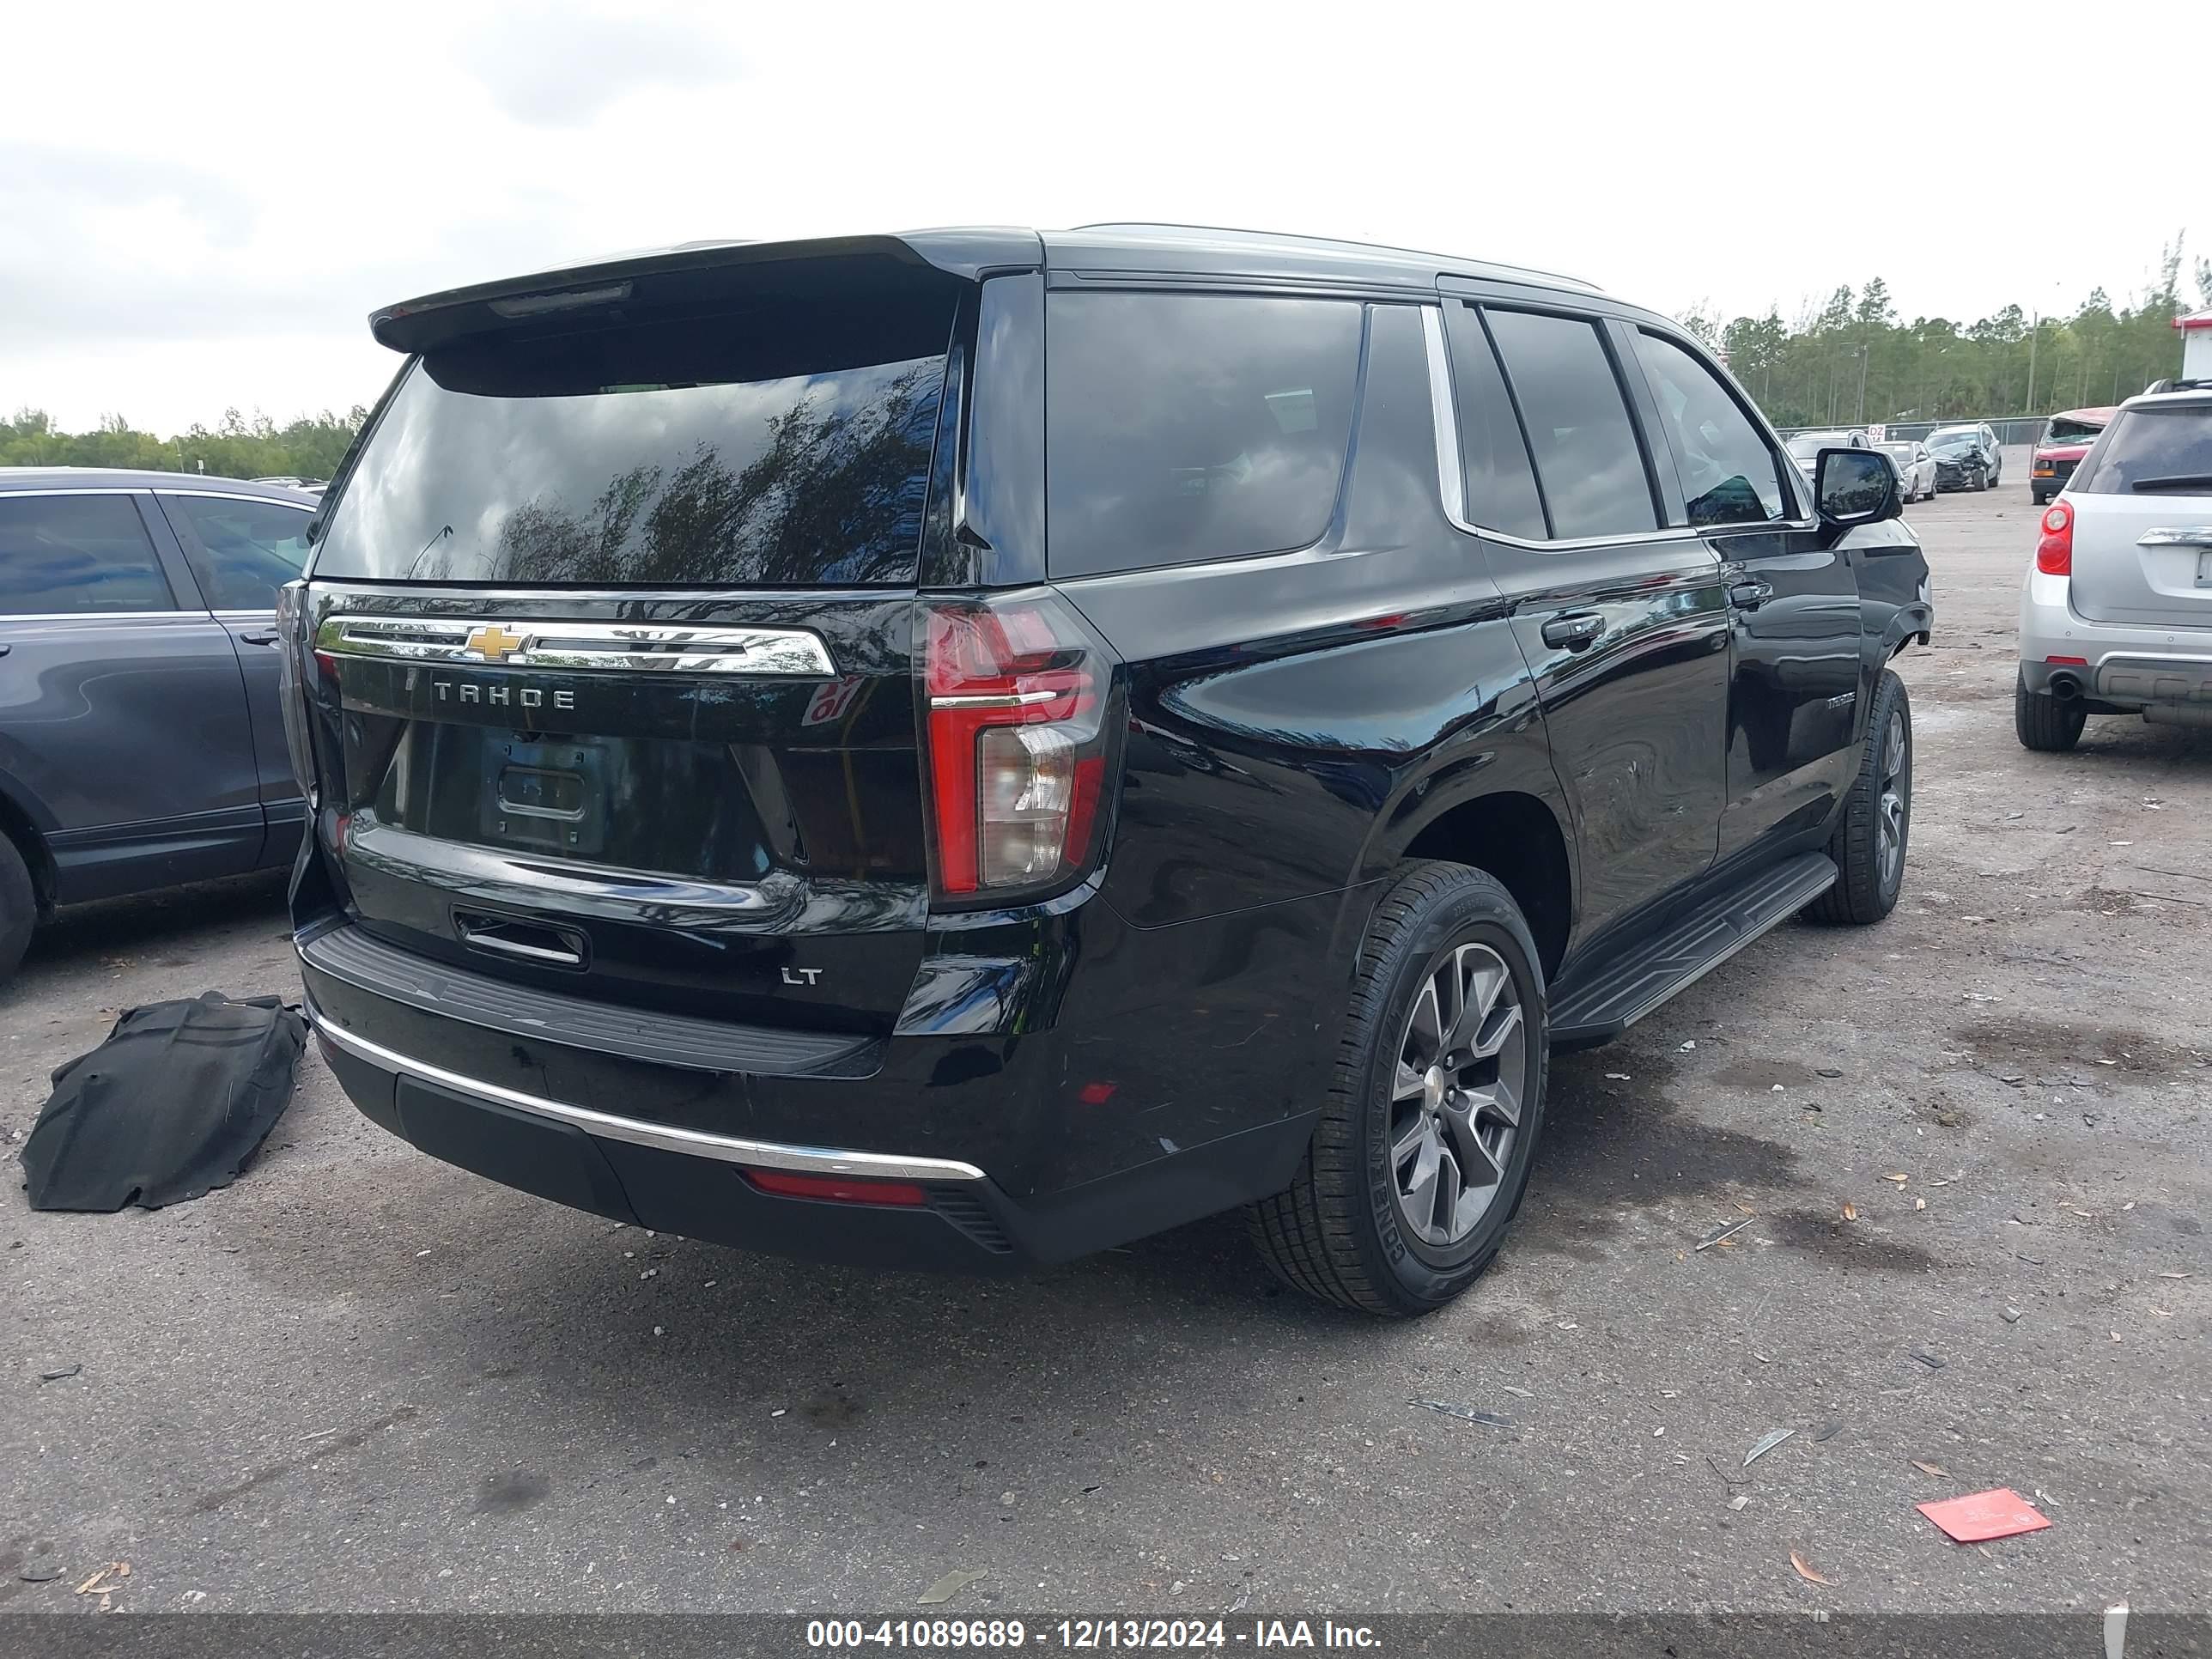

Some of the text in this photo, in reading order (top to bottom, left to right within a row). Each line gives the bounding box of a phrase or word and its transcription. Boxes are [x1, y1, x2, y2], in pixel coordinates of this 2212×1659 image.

[1870, 427, 1883, 435] DZ
[434, 682, 574, 710] TAHOE
[781, 967, 823, 985] LT
